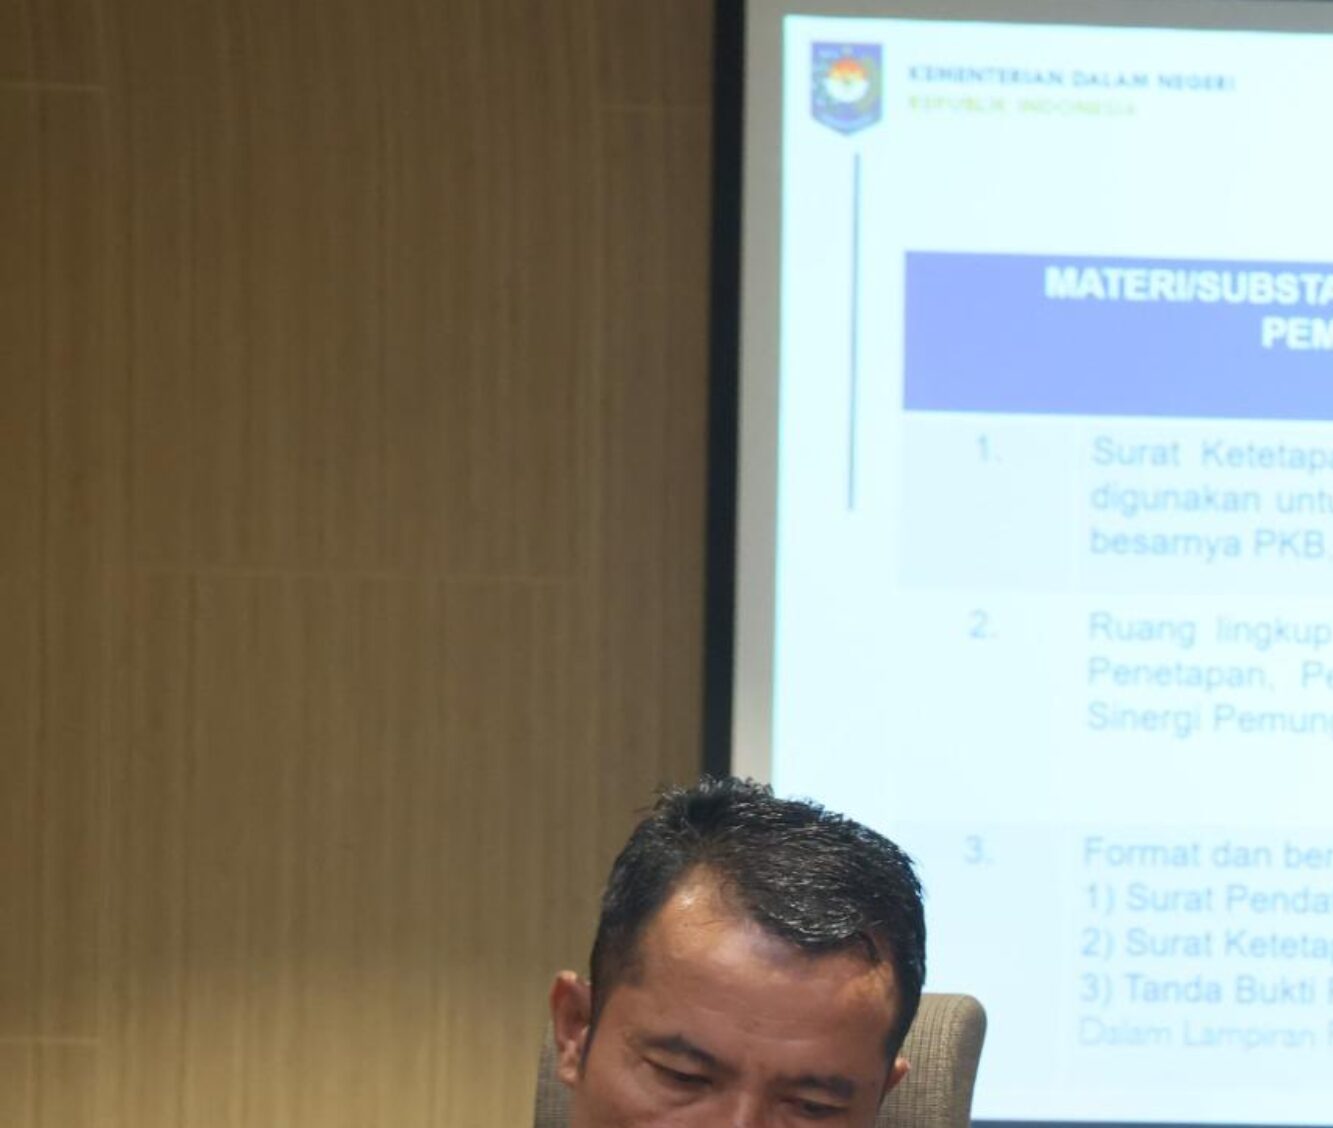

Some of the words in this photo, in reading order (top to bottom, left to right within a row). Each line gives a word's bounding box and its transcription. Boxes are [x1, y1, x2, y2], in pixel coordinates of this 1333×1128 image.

[908, 65, 1065, 87] KEMENTERIAN
[1071, 71, 1150, 90] DALAM
[1157, 73, 1235, 92] NEGERI
[1093, 435, 1180, 468] Surat
[1089, 483, 1264, 520] digunakan
[1088, 529, 1244, 561] besarnya
[1089, 611, 1197, 650] Ruang
[1217, 618, 1332, 653] lingkup
[1088, 700, 1201, 740] Sinergi
[1084, 835, 1201, 867] Format
[1211, 840, 1273, 869] dan
[1085, 882, 1118, 915] 1)
[1125, 882, 1216, 913] Surat
[1080, 927, 1117, 960] 2)
[1125, 927, 1216, 958] Surat
[1081, 972, 1114, 1007] 3)
[1124, 972, 1224, 1004] Tanda
[1234, 974, 1316, 1006] Bukti
[1081, 1015, 1171, 1046] Dalam
[1184, 1017, 1315, 1052] Lampiran
